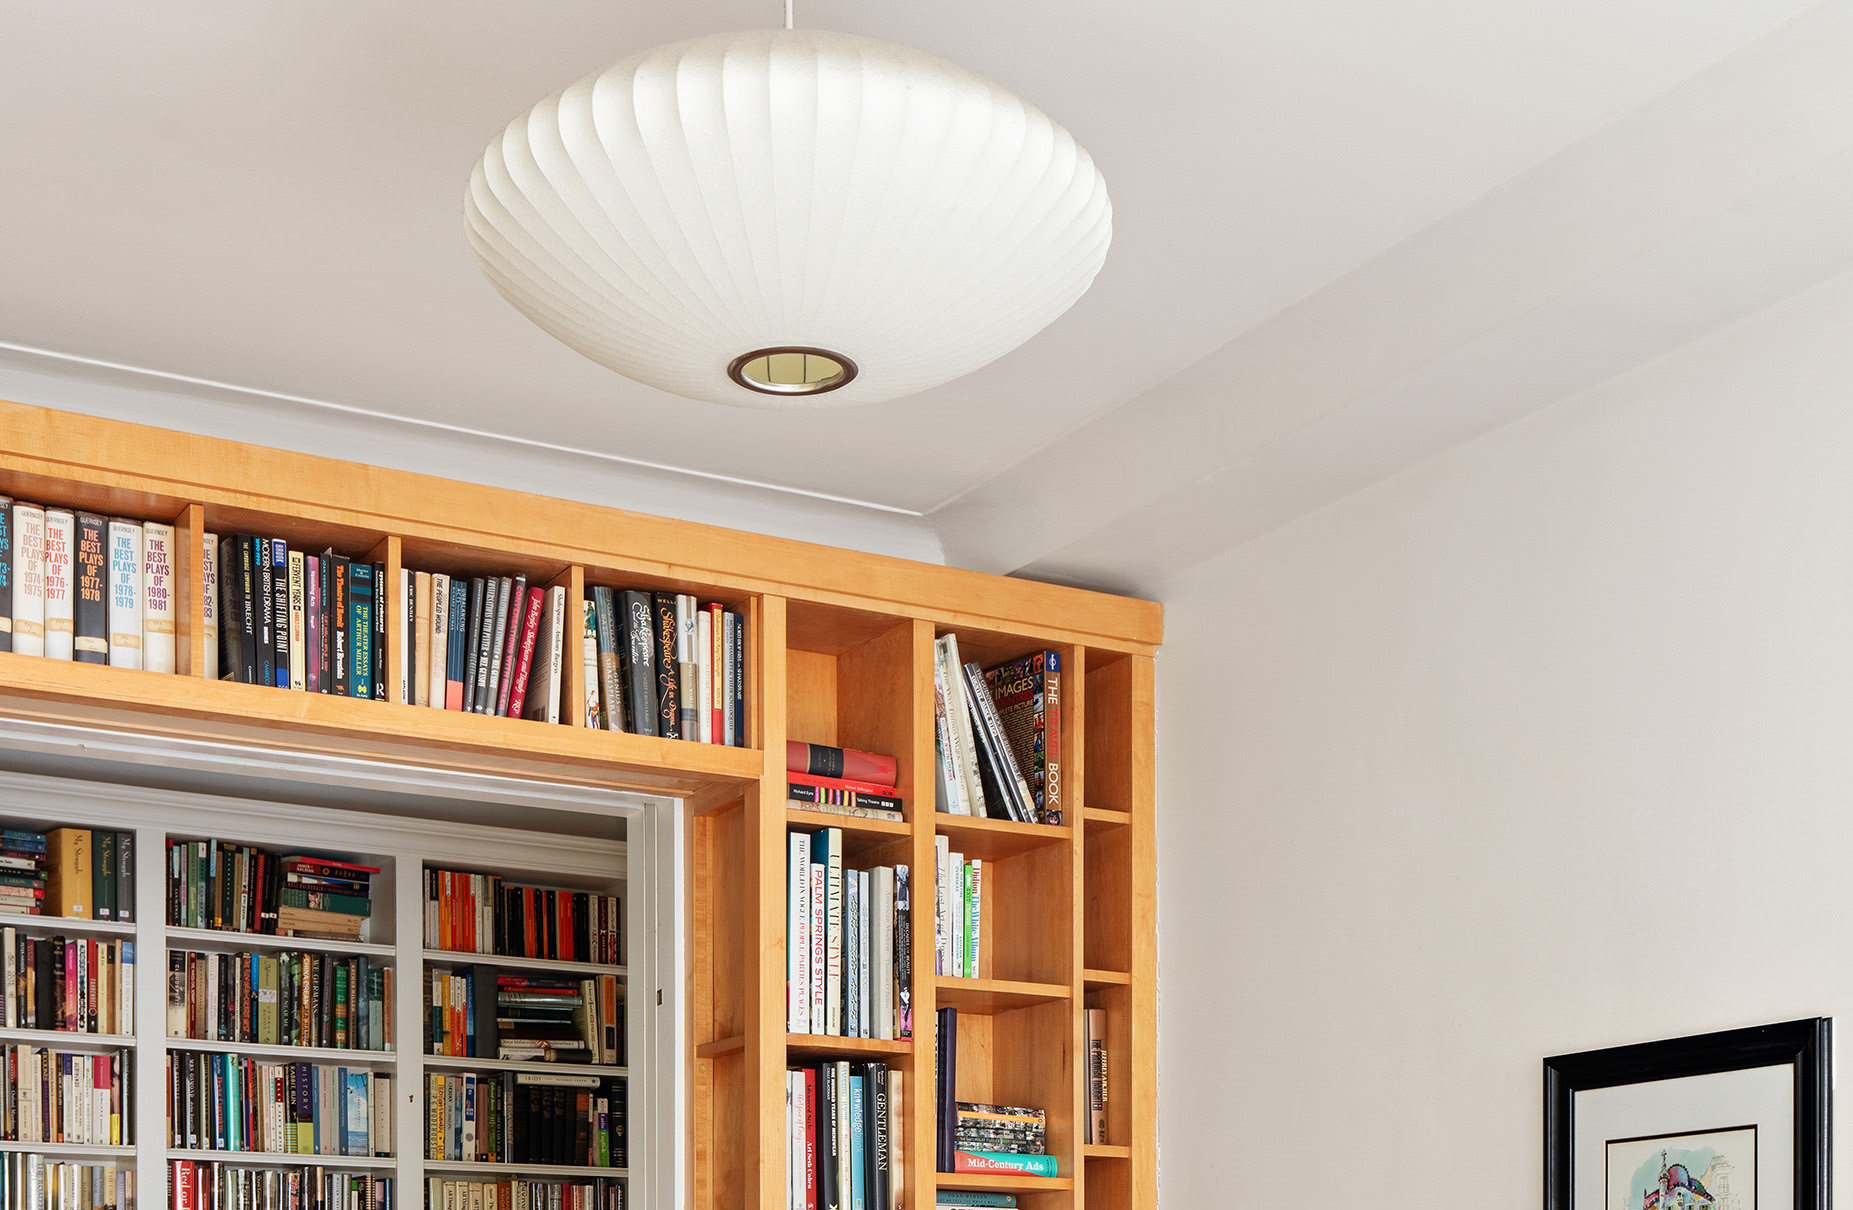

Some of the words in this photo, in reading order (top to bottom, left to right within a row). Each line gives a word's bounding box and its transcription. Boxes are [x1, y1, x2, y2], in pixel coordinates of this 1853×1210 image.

[25, 522, 40, 536] THE
[48, 527, 63, 540] THE
[83, 527, 98, 541] THE
[23, 534, 43, 549] BEST
[46, 539, 66, 553] BEST
[81, 539, 101, 553] BEST
[116, 536, 131, 549] THE
[149, 539, 164, 552] THE
[21, 546, 46, 562] PLAYS
[45, 551, 69, 565] PLAYS
[79, 552, 103, 566] PLAYS
[114, 549, 134, 561] BEST
[147, 551, 167, 564] BEST
[28, 559, 38, 571] OF
[51, 564, 62, 575] OF
[87, 564, 97, 576] OF
[113, 561, 137, 574] PLAYS
[145, 562, 170, 576] PLAYS
[46, 576, 69, 587] 1976-
[81, 575, 103, 589] 1977-
[120, 573, 131, 584] OF
[153, 575, 164, 587] OF
[275, 577, 286, 591] THE
[24, 584, 42, 597] 1975
[46, 588, 65, 600] 1977
[81, 587, 100, 602] 1978
[115, 584, 136, 597] 1978-
[147, 586, 170, 599] 1980-
[115, 596, 134, 609] 1979
[148, 598, 167, 611] 1981
[356, 604, 362, 615] OF
[275, 594, 287, 628] SHIFTING
[506, 585, 523, 655] CONVERSATIONS
[276, 630, 288, 654] POINT
[636, 604, 652, 668] Shakespeare
[503, 655, 514, 677] WITH
[995, 677, 1034, 700] IMAGES
[1047, 677, 1058, 705] THE
[1048, 708, 1058, 758] TRAVEL
[1048, 763, 1059, 804] BOOK
[73, 834, 83, 845] My
[102, 837, 112, 847] My
[121, 838, 131, 849] My
[73, 847, 84, 874] Struggle
[102, 849, 112, 876] Struggle
[121, 851, 131, 878] Struggle
[814, 870, 823, 904] PALM
[972, 867, 981, 894] Didion
[799, 884, 805, 894] IN
[829, 853, 840, 932] ULTIMATE
[972, 895, 980, 911] The
[971, 911, 980, 935] White
[814, 908, 823, 964] SPRINGS
[971, 936, 979, 962] Album
[829, 935, 840, 982] STYLE
[814, 967, 823, 1006] STYLE
[312, 974, 320, 1014] GERMANS
[877, 1093, 888, 1171] GENTLEMAN
[967, 1158, 1024, 1171] Mid-Century
[1026, 1161, 1044, 1171] Ads
[181, 1168, 191, 1188] Red
[182, 1191, 189, 1204] or
